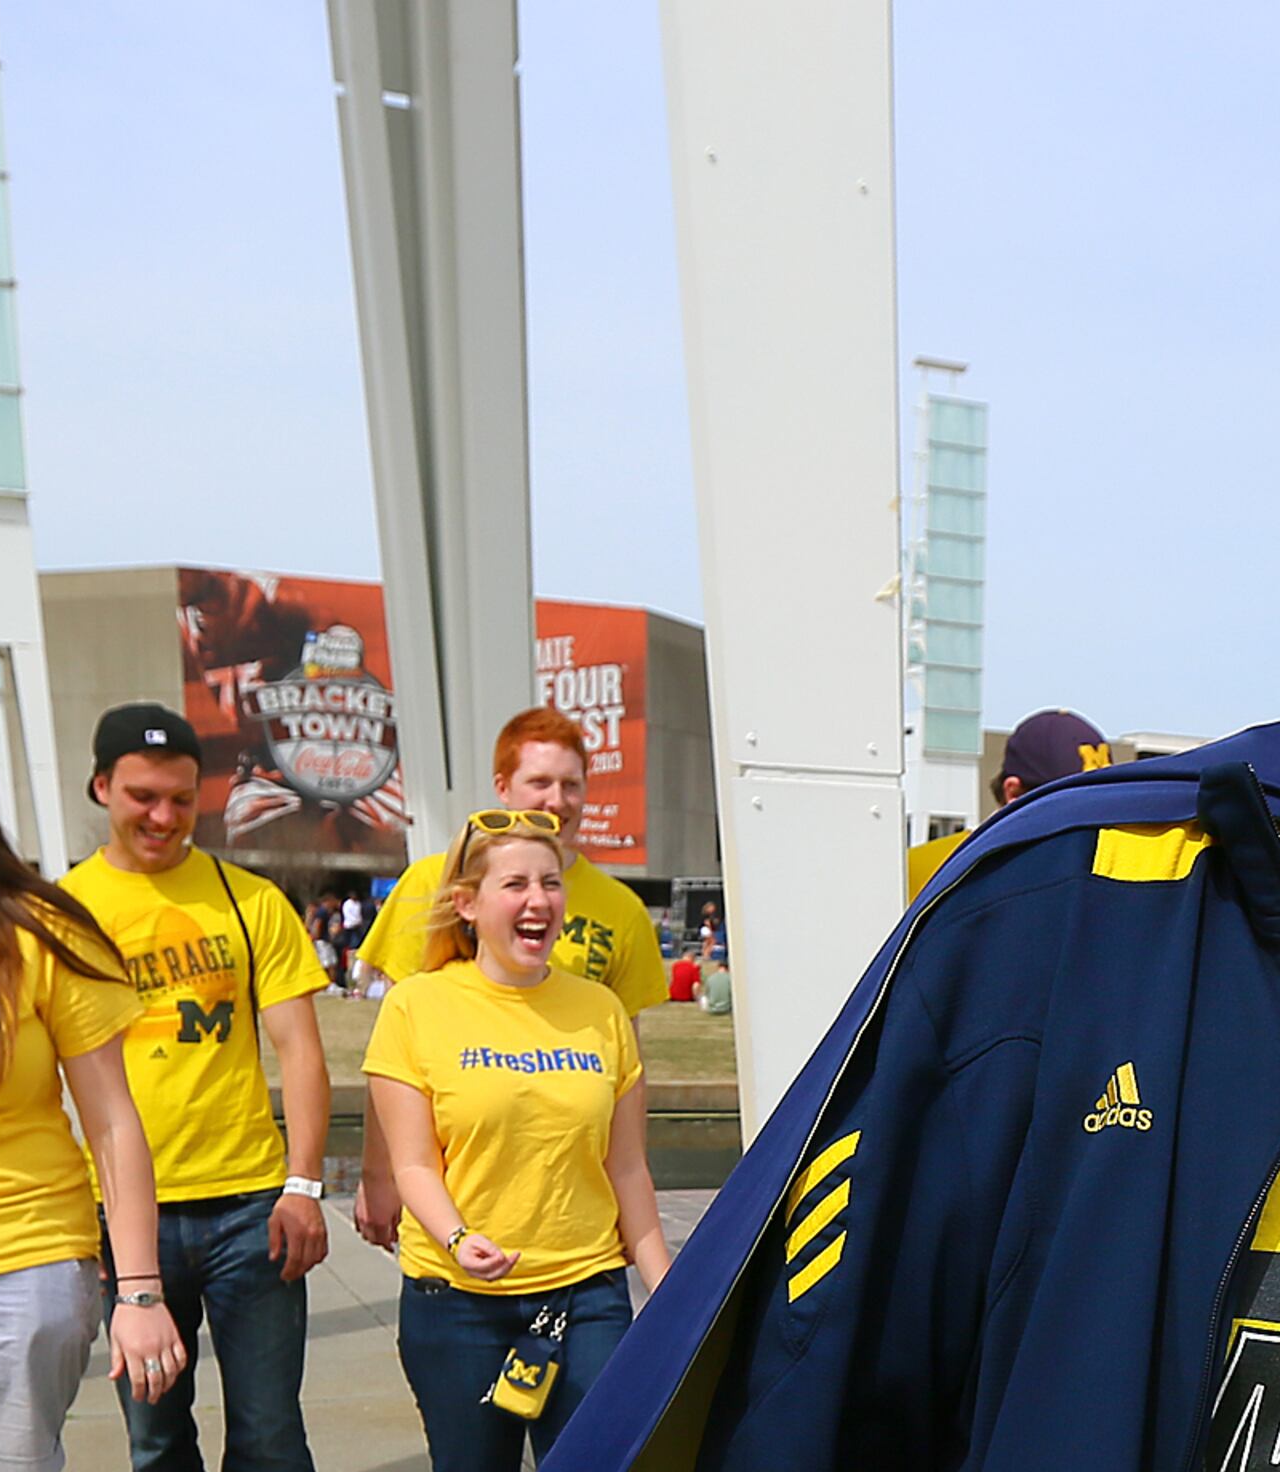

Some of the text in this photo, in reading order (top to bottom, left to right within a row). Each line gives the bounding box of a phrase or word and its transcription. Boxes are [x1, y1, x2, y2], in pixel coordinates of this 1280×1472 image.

[538, 663, 623, 712] FOUR
[282, 711, 385, 744] TOWN
[568, 704, 626, 749] ST
[1078, 743, 1114, 772] M
[164, 935, 236, 982] RAGE
[586, 920, 614, 981] MAI
[176, 1000, 235, 1043] M
[460, 1046, 604, 1074] #FreshFive
[506, 1358, 541, 1387] M
